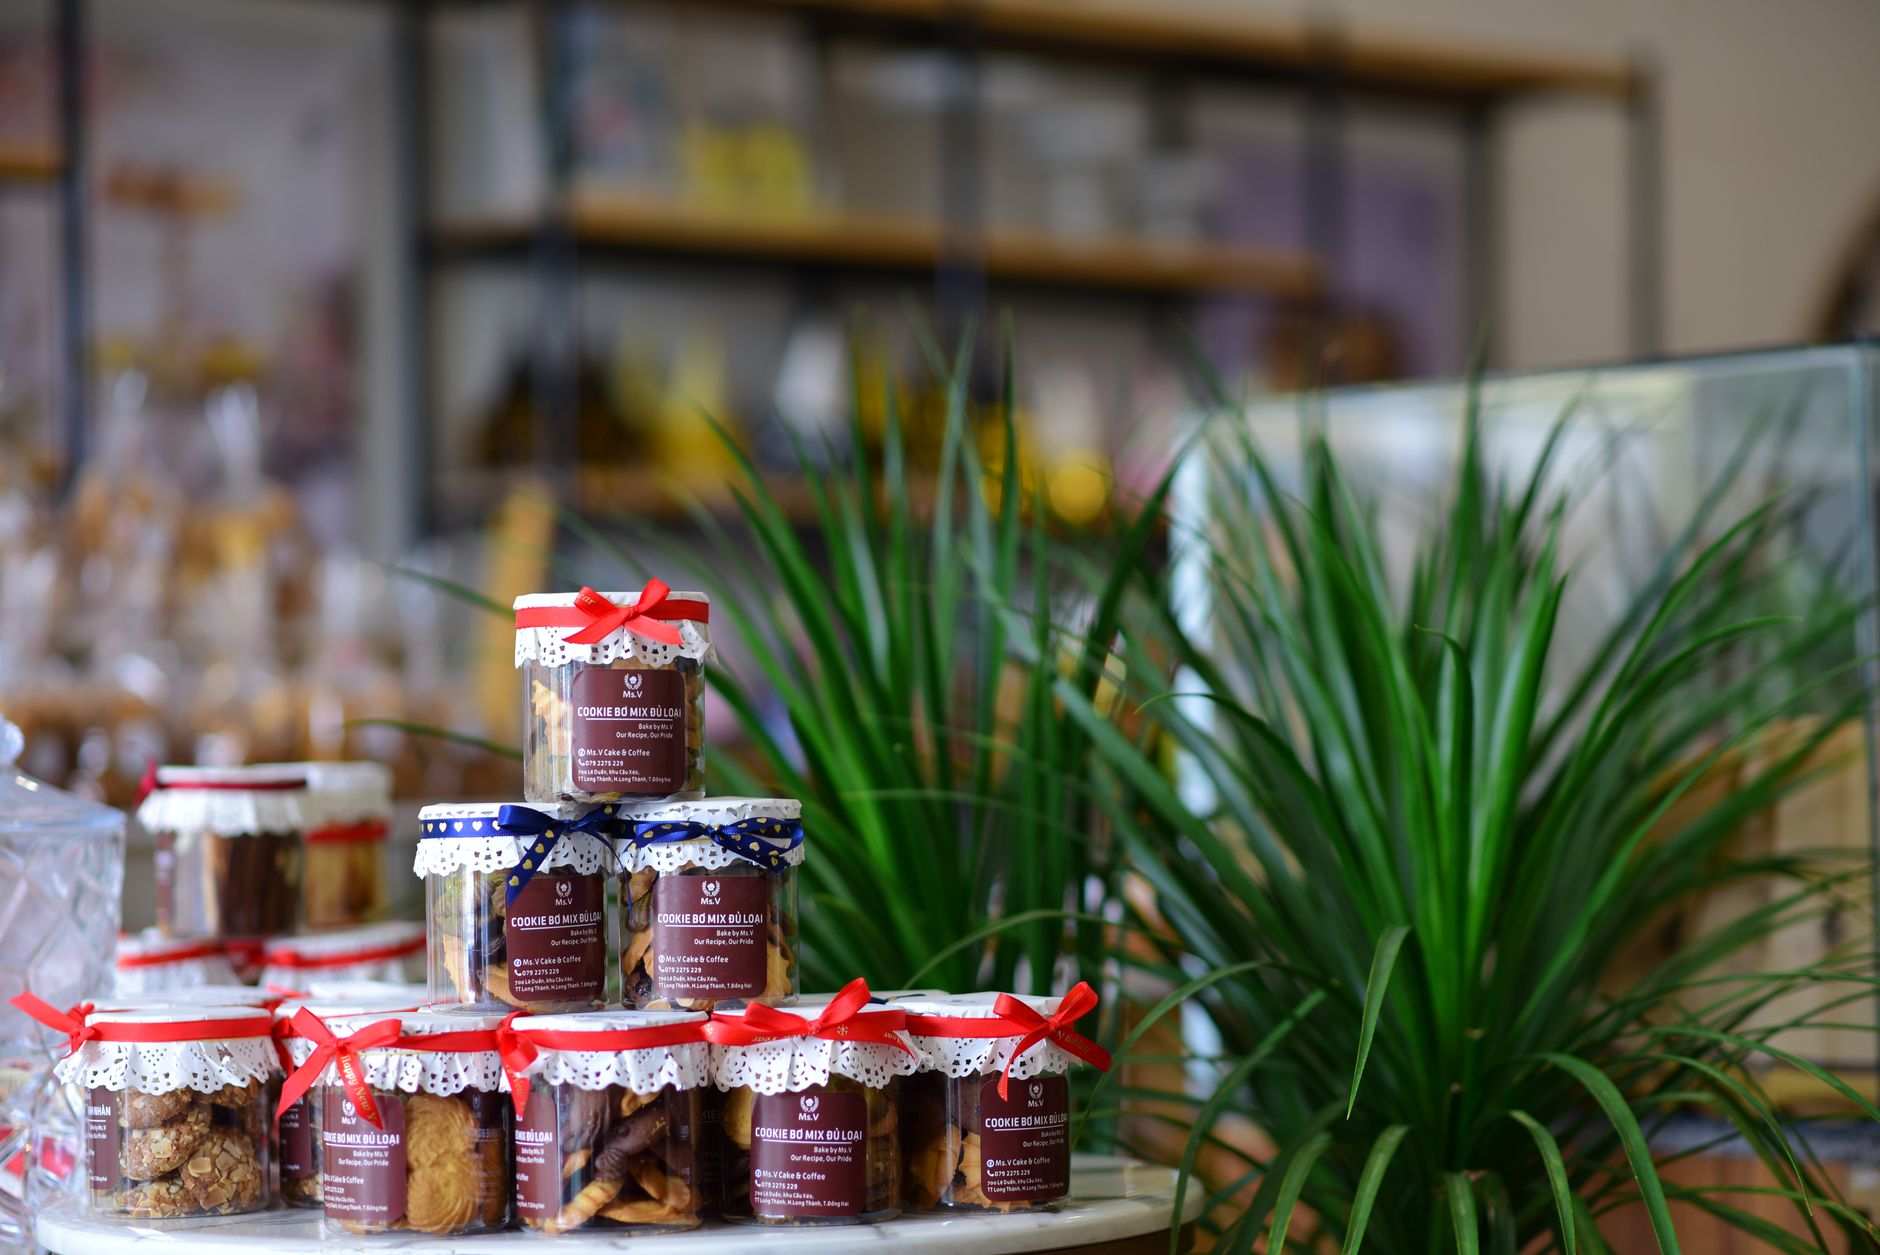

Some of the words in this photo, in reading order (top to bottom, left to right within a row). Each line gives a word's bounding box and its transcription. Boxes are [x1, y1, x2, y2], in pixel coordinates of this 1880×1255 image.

[577, 707, 612, 717] COOKIE
[615, 706, 628, 717] BƠ
[630, 707, 648, 717] MIX
[650, 705, 662, 717] ĐỦ
[664, 708, 682, 719] LOẠI
[628, 732, 649, 740] Recipe,
[555, 898, 572, 906] Ms.V
[511, 916, 546, 927] COOKIE
[548, 914, 560, 925] BƠ
[562, 914, 578, 924] MIX
[657, 914, 690, 924] COOKIE
[693, 913, 705, 924] BƠ
[708, 914, 726, 924] MIX
[728, 911, 741, 924] ĐỦ
[743, 914, 763, 925] LOẠI
[522, 958, 539, 966] Ms.V
[540, 957, 556, 965] Cake
[1028, 1100, 1044, 1108] Ms.V
[342, 1117, 356, 1125] Ms.V
[985, 1117, 1019, 1128] COOKIE
[1021, 1115, 1032, 1126] BƠ
[1034, 1114, 1048, 1126] MIX
[347, 1133, 361, 1144] MIX
[363, 1132, 375, 1144] ĐỦ
[377, 1134, 400, 1146] LOẠI
[535, 1132, 552, 1143] LOẠI
[755, 1127, 788, 1139] COOKIE
[790, 1128, 803, 1139] BƠ
[805, 1130, 824, 1140] MIX
[826, 1128, 840, 1140] ĐỦ
[841, 1130, 862, 1142] LOẠI
[778, 1171, 794, 1179] Cake
[802, 1172, 825, 1180] Coffee
